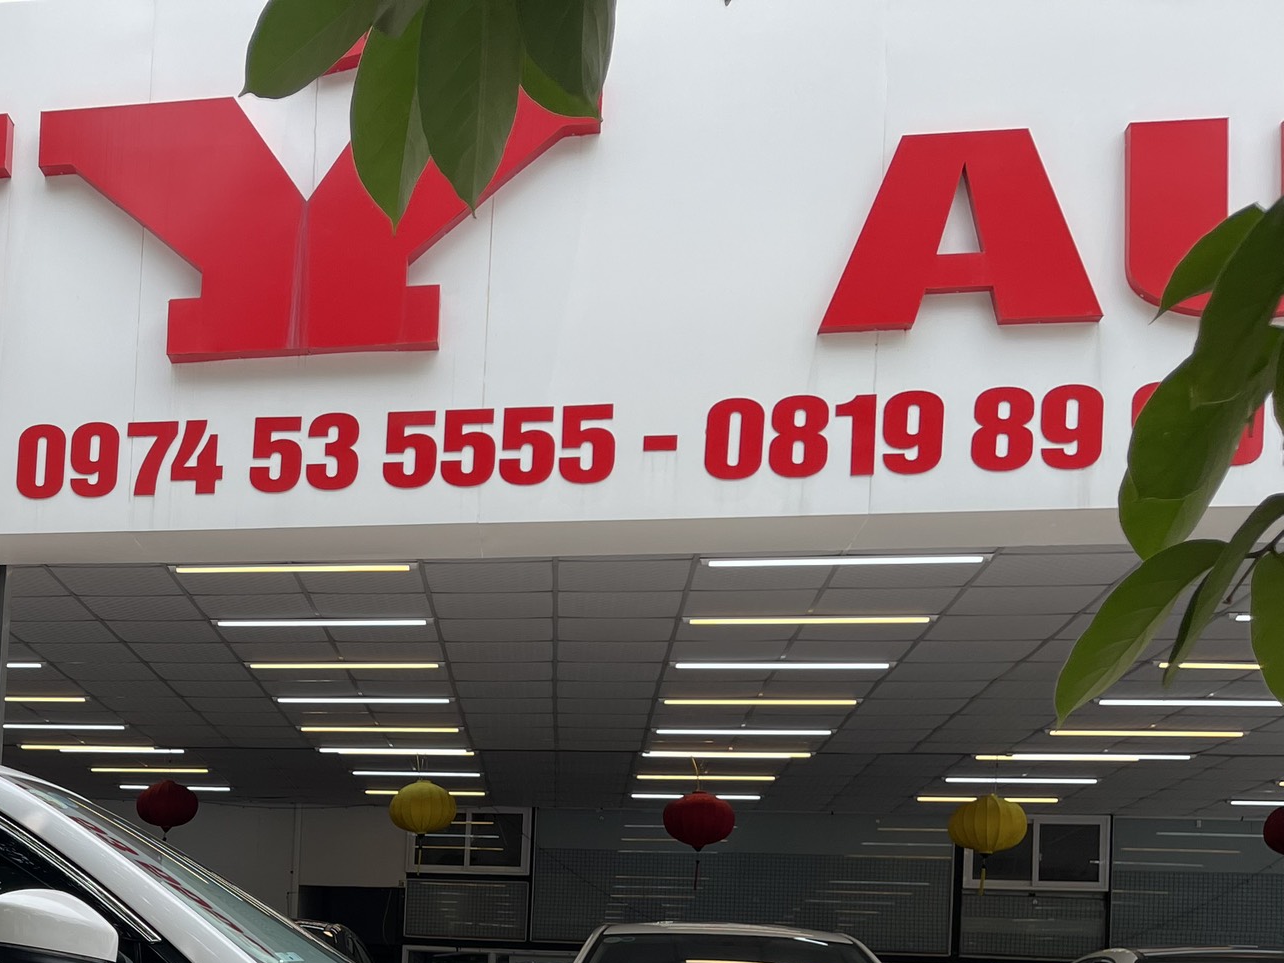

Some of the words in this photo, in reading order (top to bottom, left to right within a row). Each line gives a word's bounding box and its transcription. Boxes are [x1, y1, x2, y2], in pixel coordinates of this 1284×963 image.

[16, 419, 224, 500] 0974
[249, 413, 360, 494] 53
[382, 403, 616, 489] 5555
[704, 391, 945, 481] 0819
[970, 383, 1105, 473] 89
